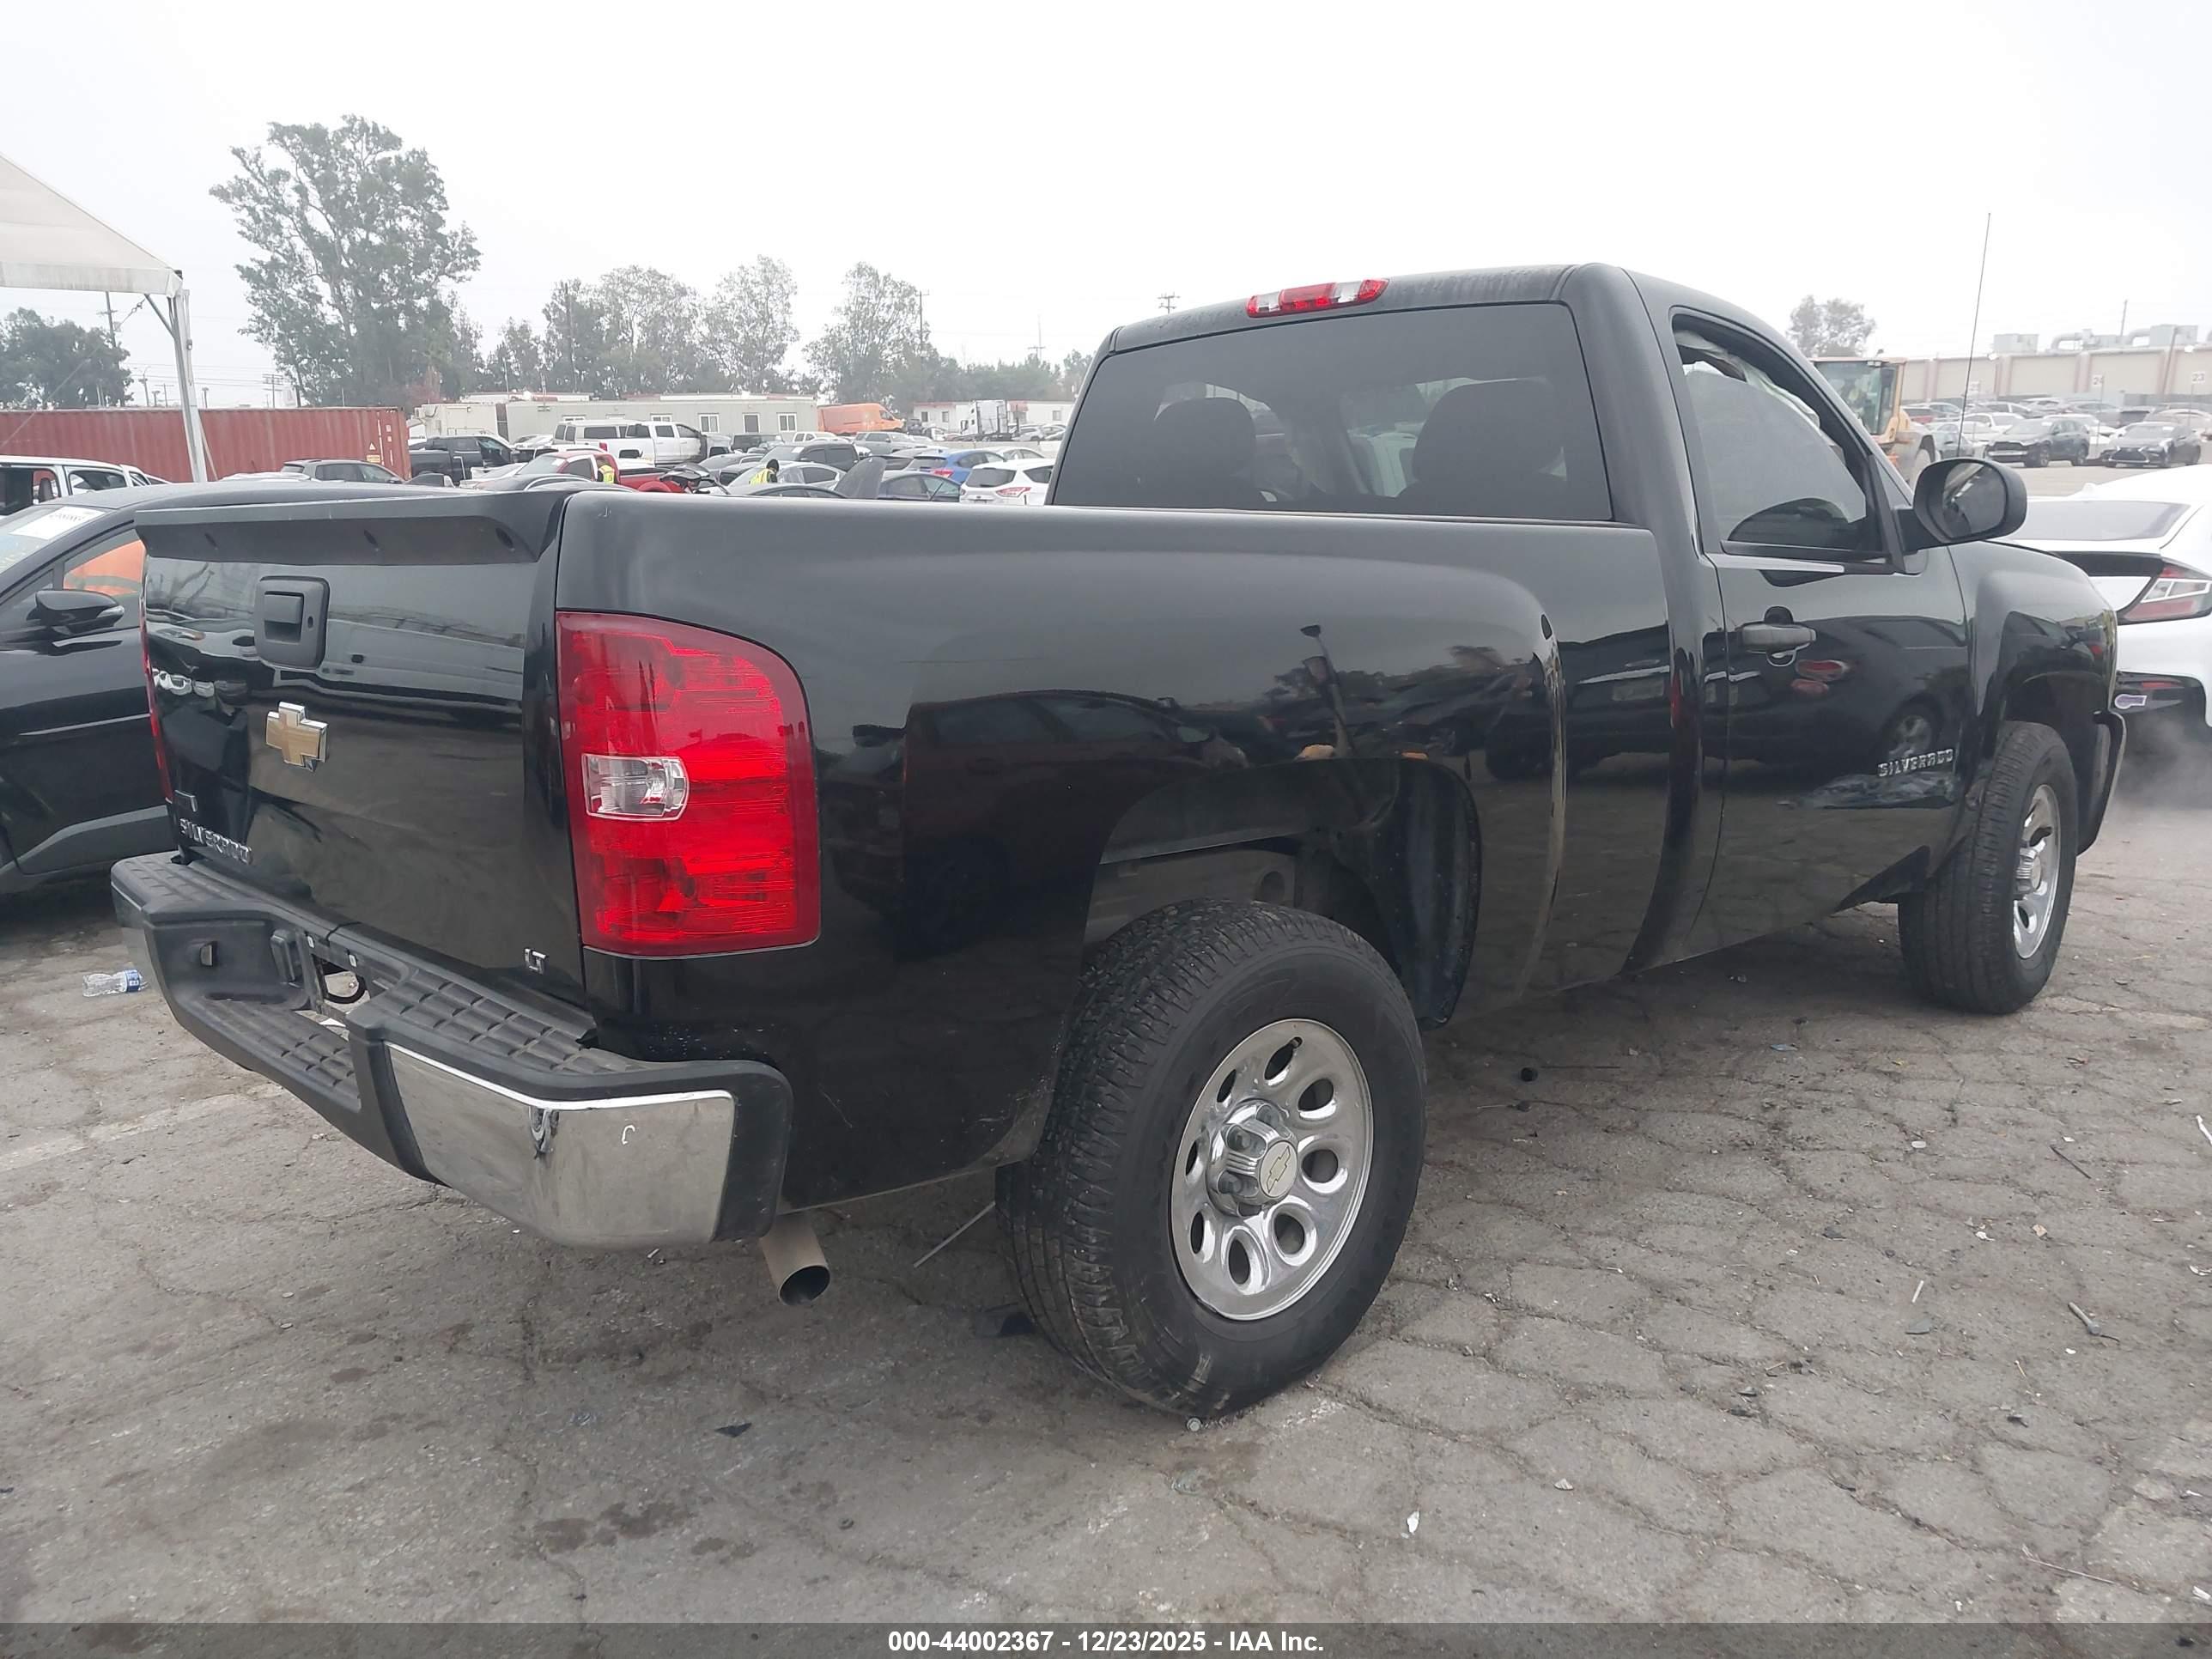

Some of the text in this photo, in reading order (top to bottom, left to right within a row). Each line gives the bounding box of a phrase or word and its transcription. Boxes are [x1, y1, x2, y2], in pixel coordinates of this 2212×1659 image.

[1877, 748, 1954, 777] SILVERADO
[179, 817, 252, 865] SILVERADO
[524, 948, 547, 975] LT
